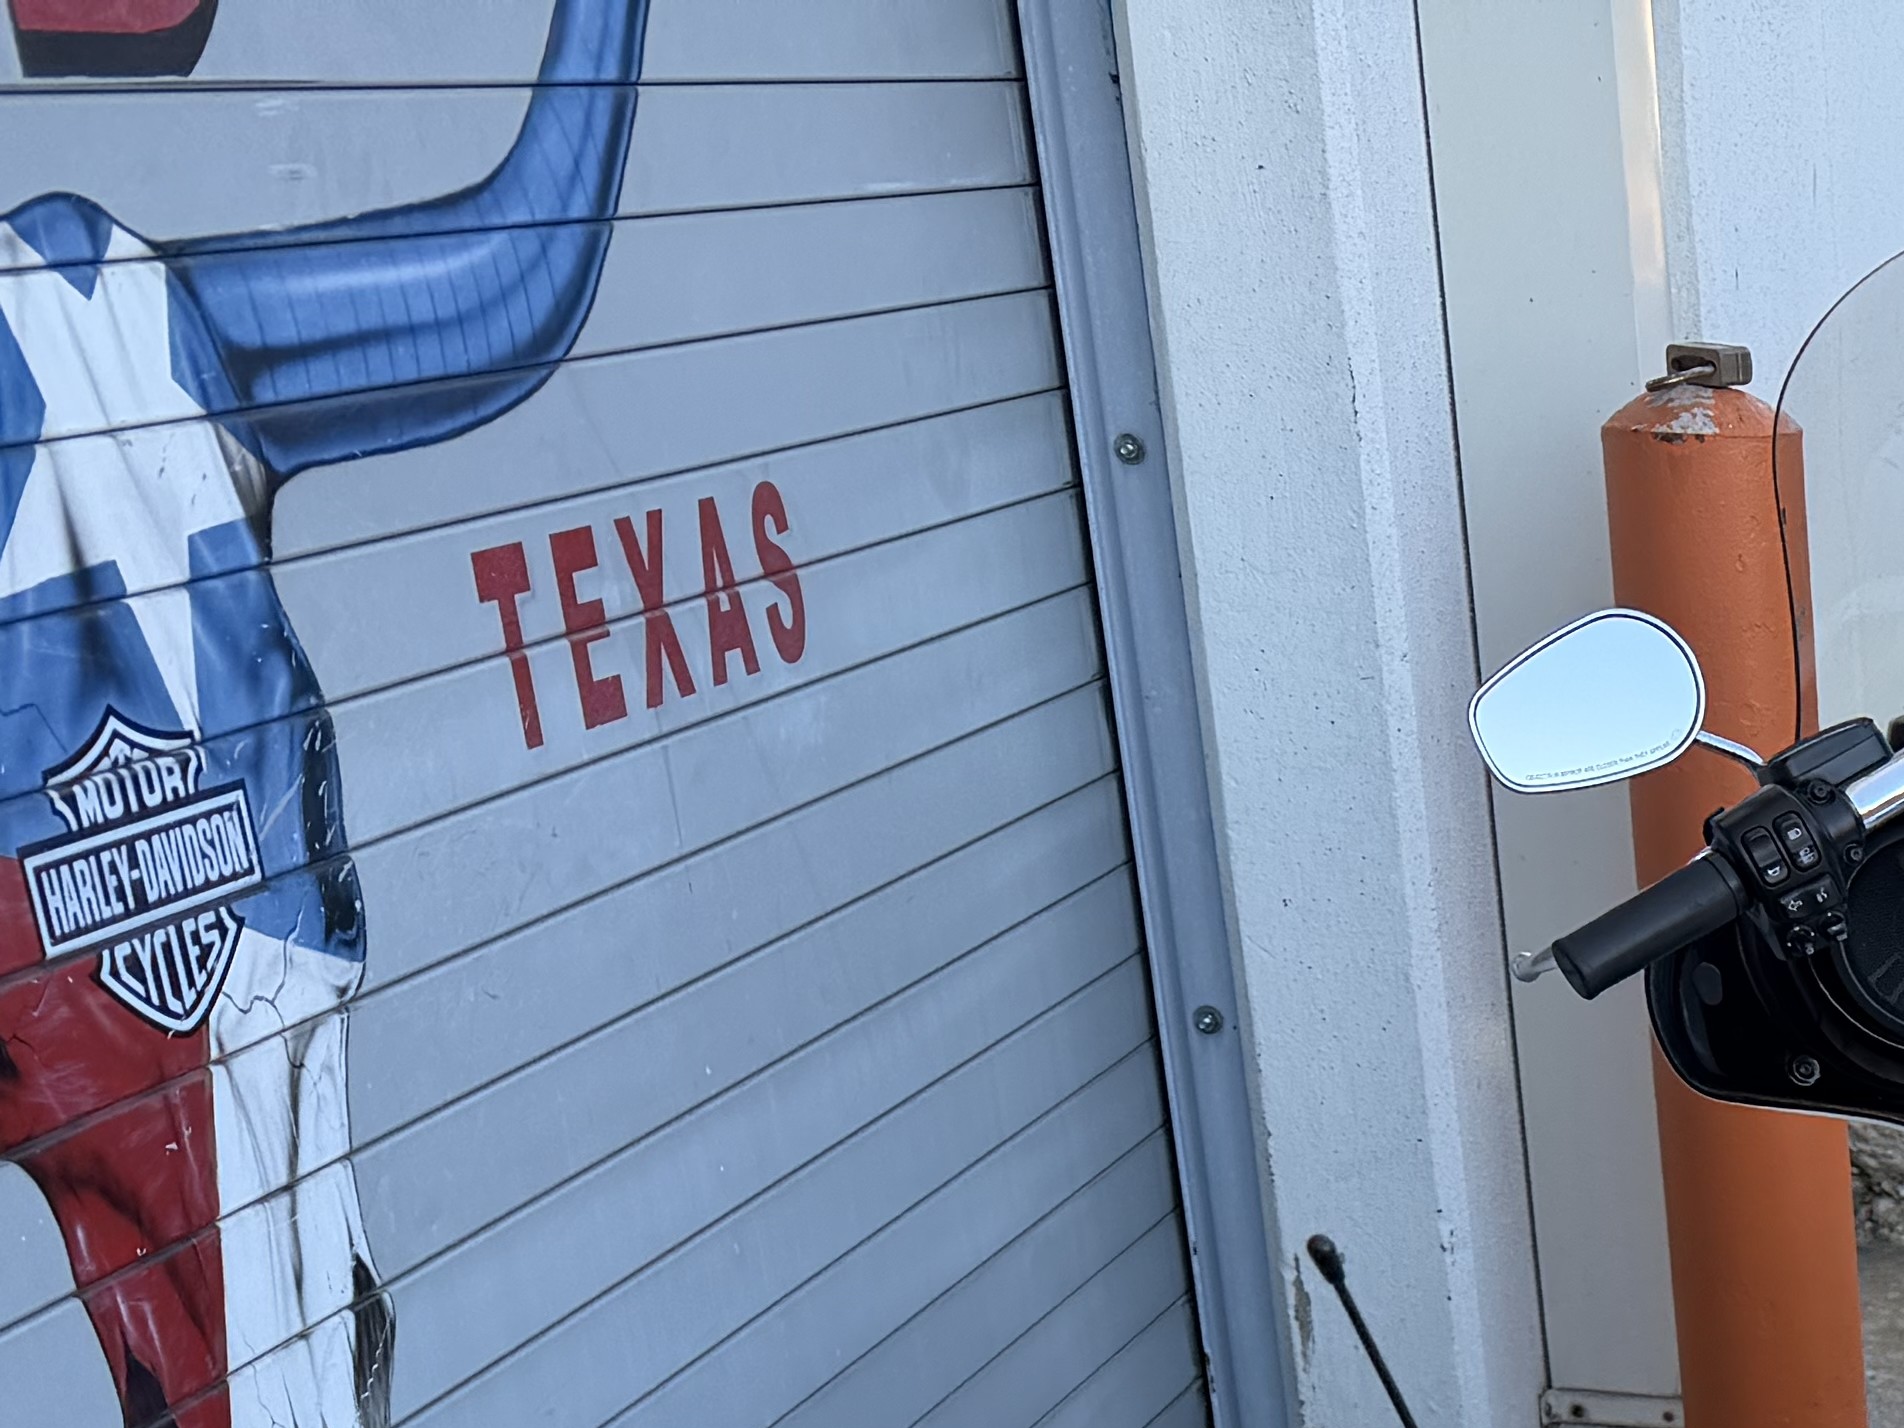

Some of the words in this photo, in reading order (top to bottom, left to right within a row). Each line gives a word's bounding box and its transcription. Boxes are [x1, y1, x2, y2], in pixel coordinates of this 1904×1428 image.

[470, 479, 807, 750] TEXAS
[73, 755, 186, 828] MOTOR
[41, 810, 250, 937] HARLEY-DAVIDSON
[114, 910, 220, 1014] CYCLES
